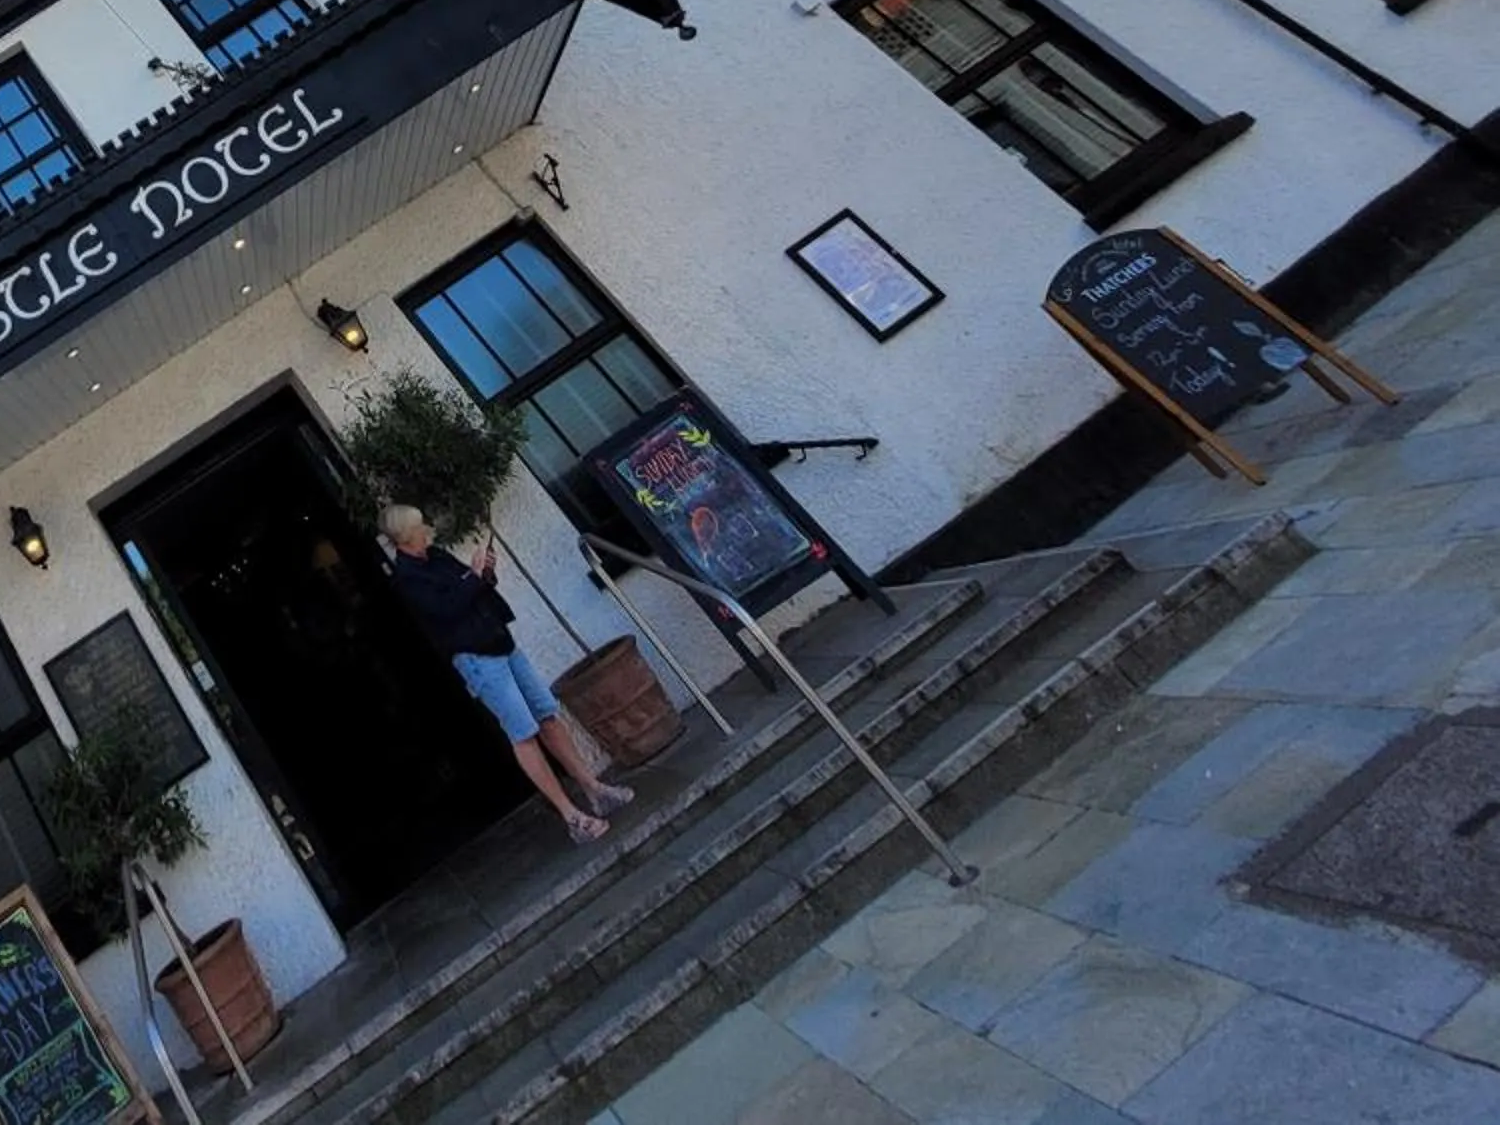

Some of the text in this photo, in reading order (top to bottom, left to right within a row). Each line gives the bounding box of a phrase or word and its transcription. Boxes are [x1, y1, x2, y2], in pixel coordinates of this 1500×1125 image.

[130, 88, 342, 240] HOTEL
[1080, 253, 1159, 303] THATCHERS
[0, 996, 53, 1061] DAY
